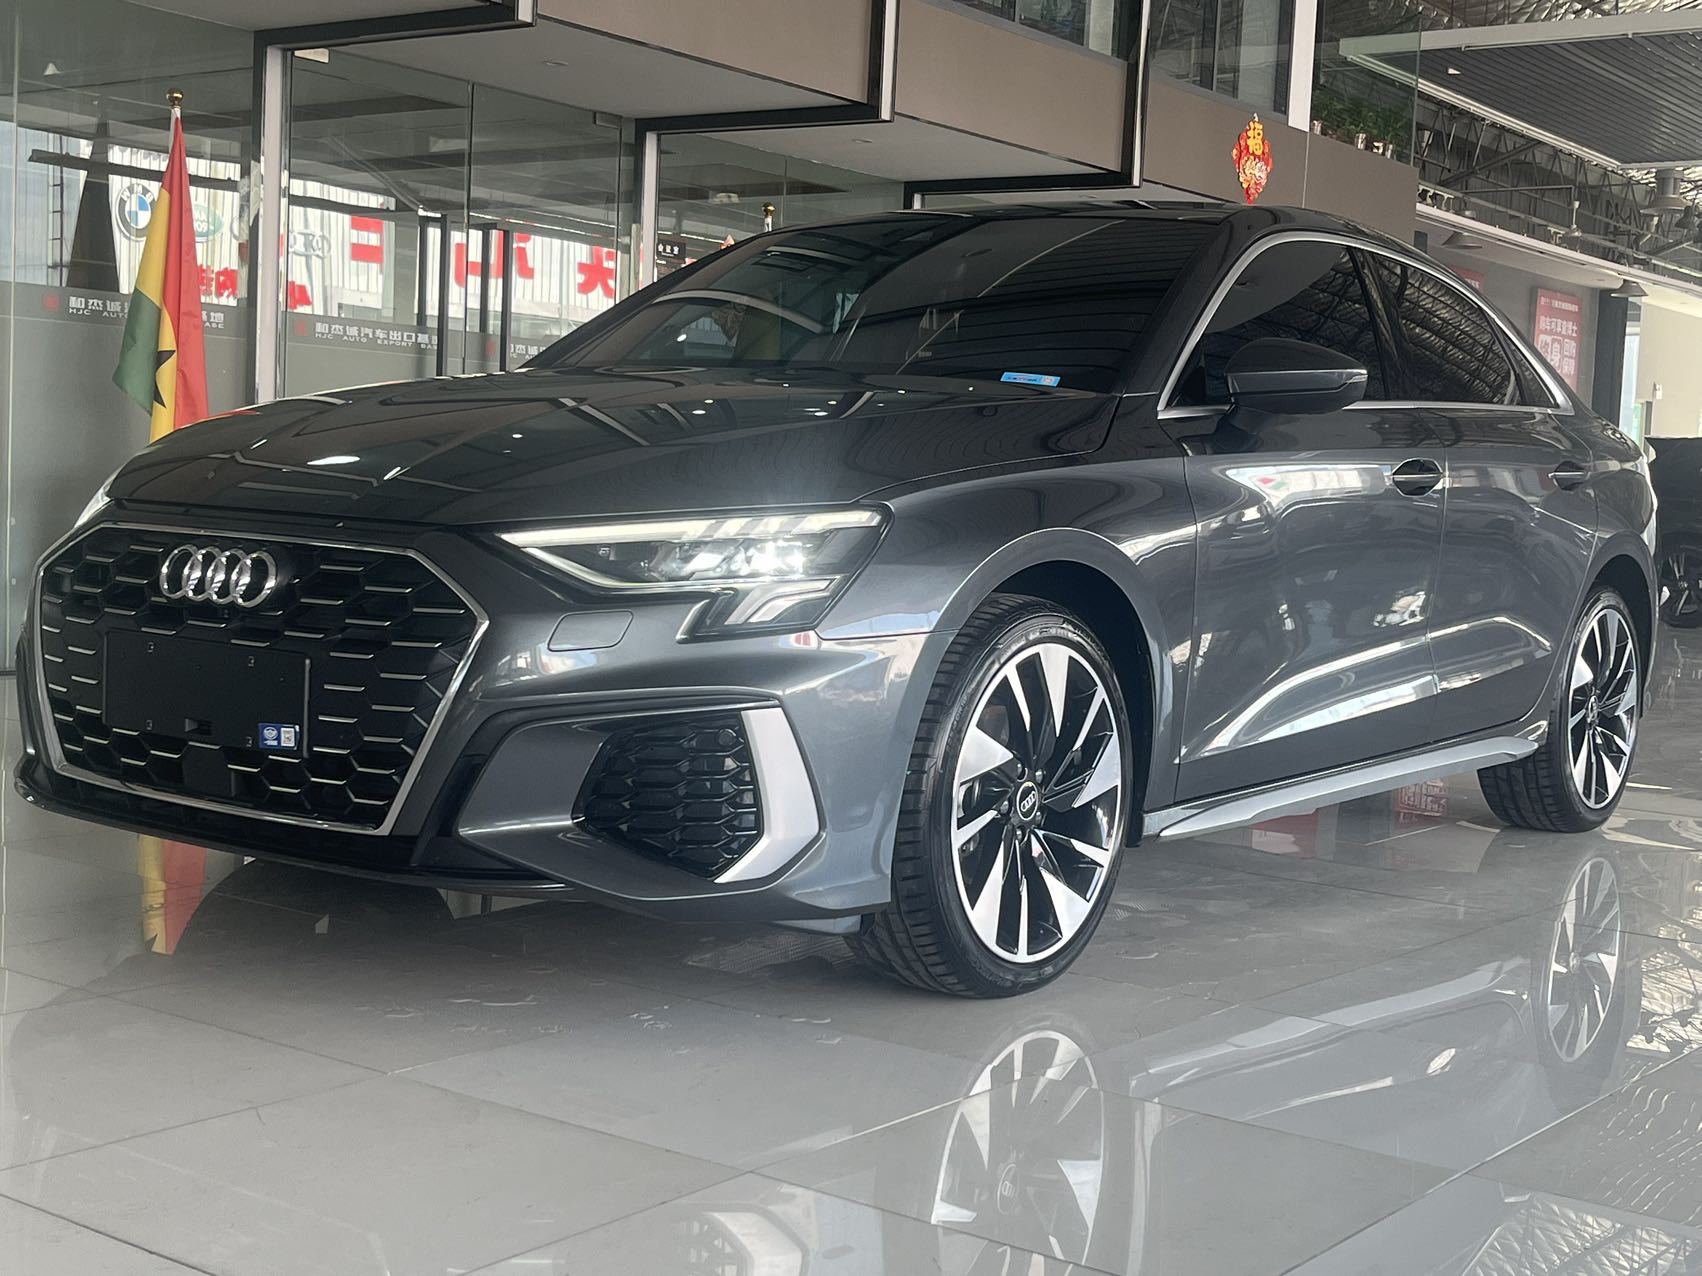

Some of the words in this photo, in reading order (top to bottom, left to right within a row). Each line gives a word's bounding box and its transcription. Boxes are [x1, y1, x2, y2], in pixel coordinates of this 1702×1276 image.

[1246, 120, 1263, 155] 福
[69, 308, 91, 316] HJC
[204, 321, 225, 329] ASE
[315, 332, 334, 340] HJC
[342, 335, 367, 343] AUTO
[377, 338, 413, 347] EXPORT
